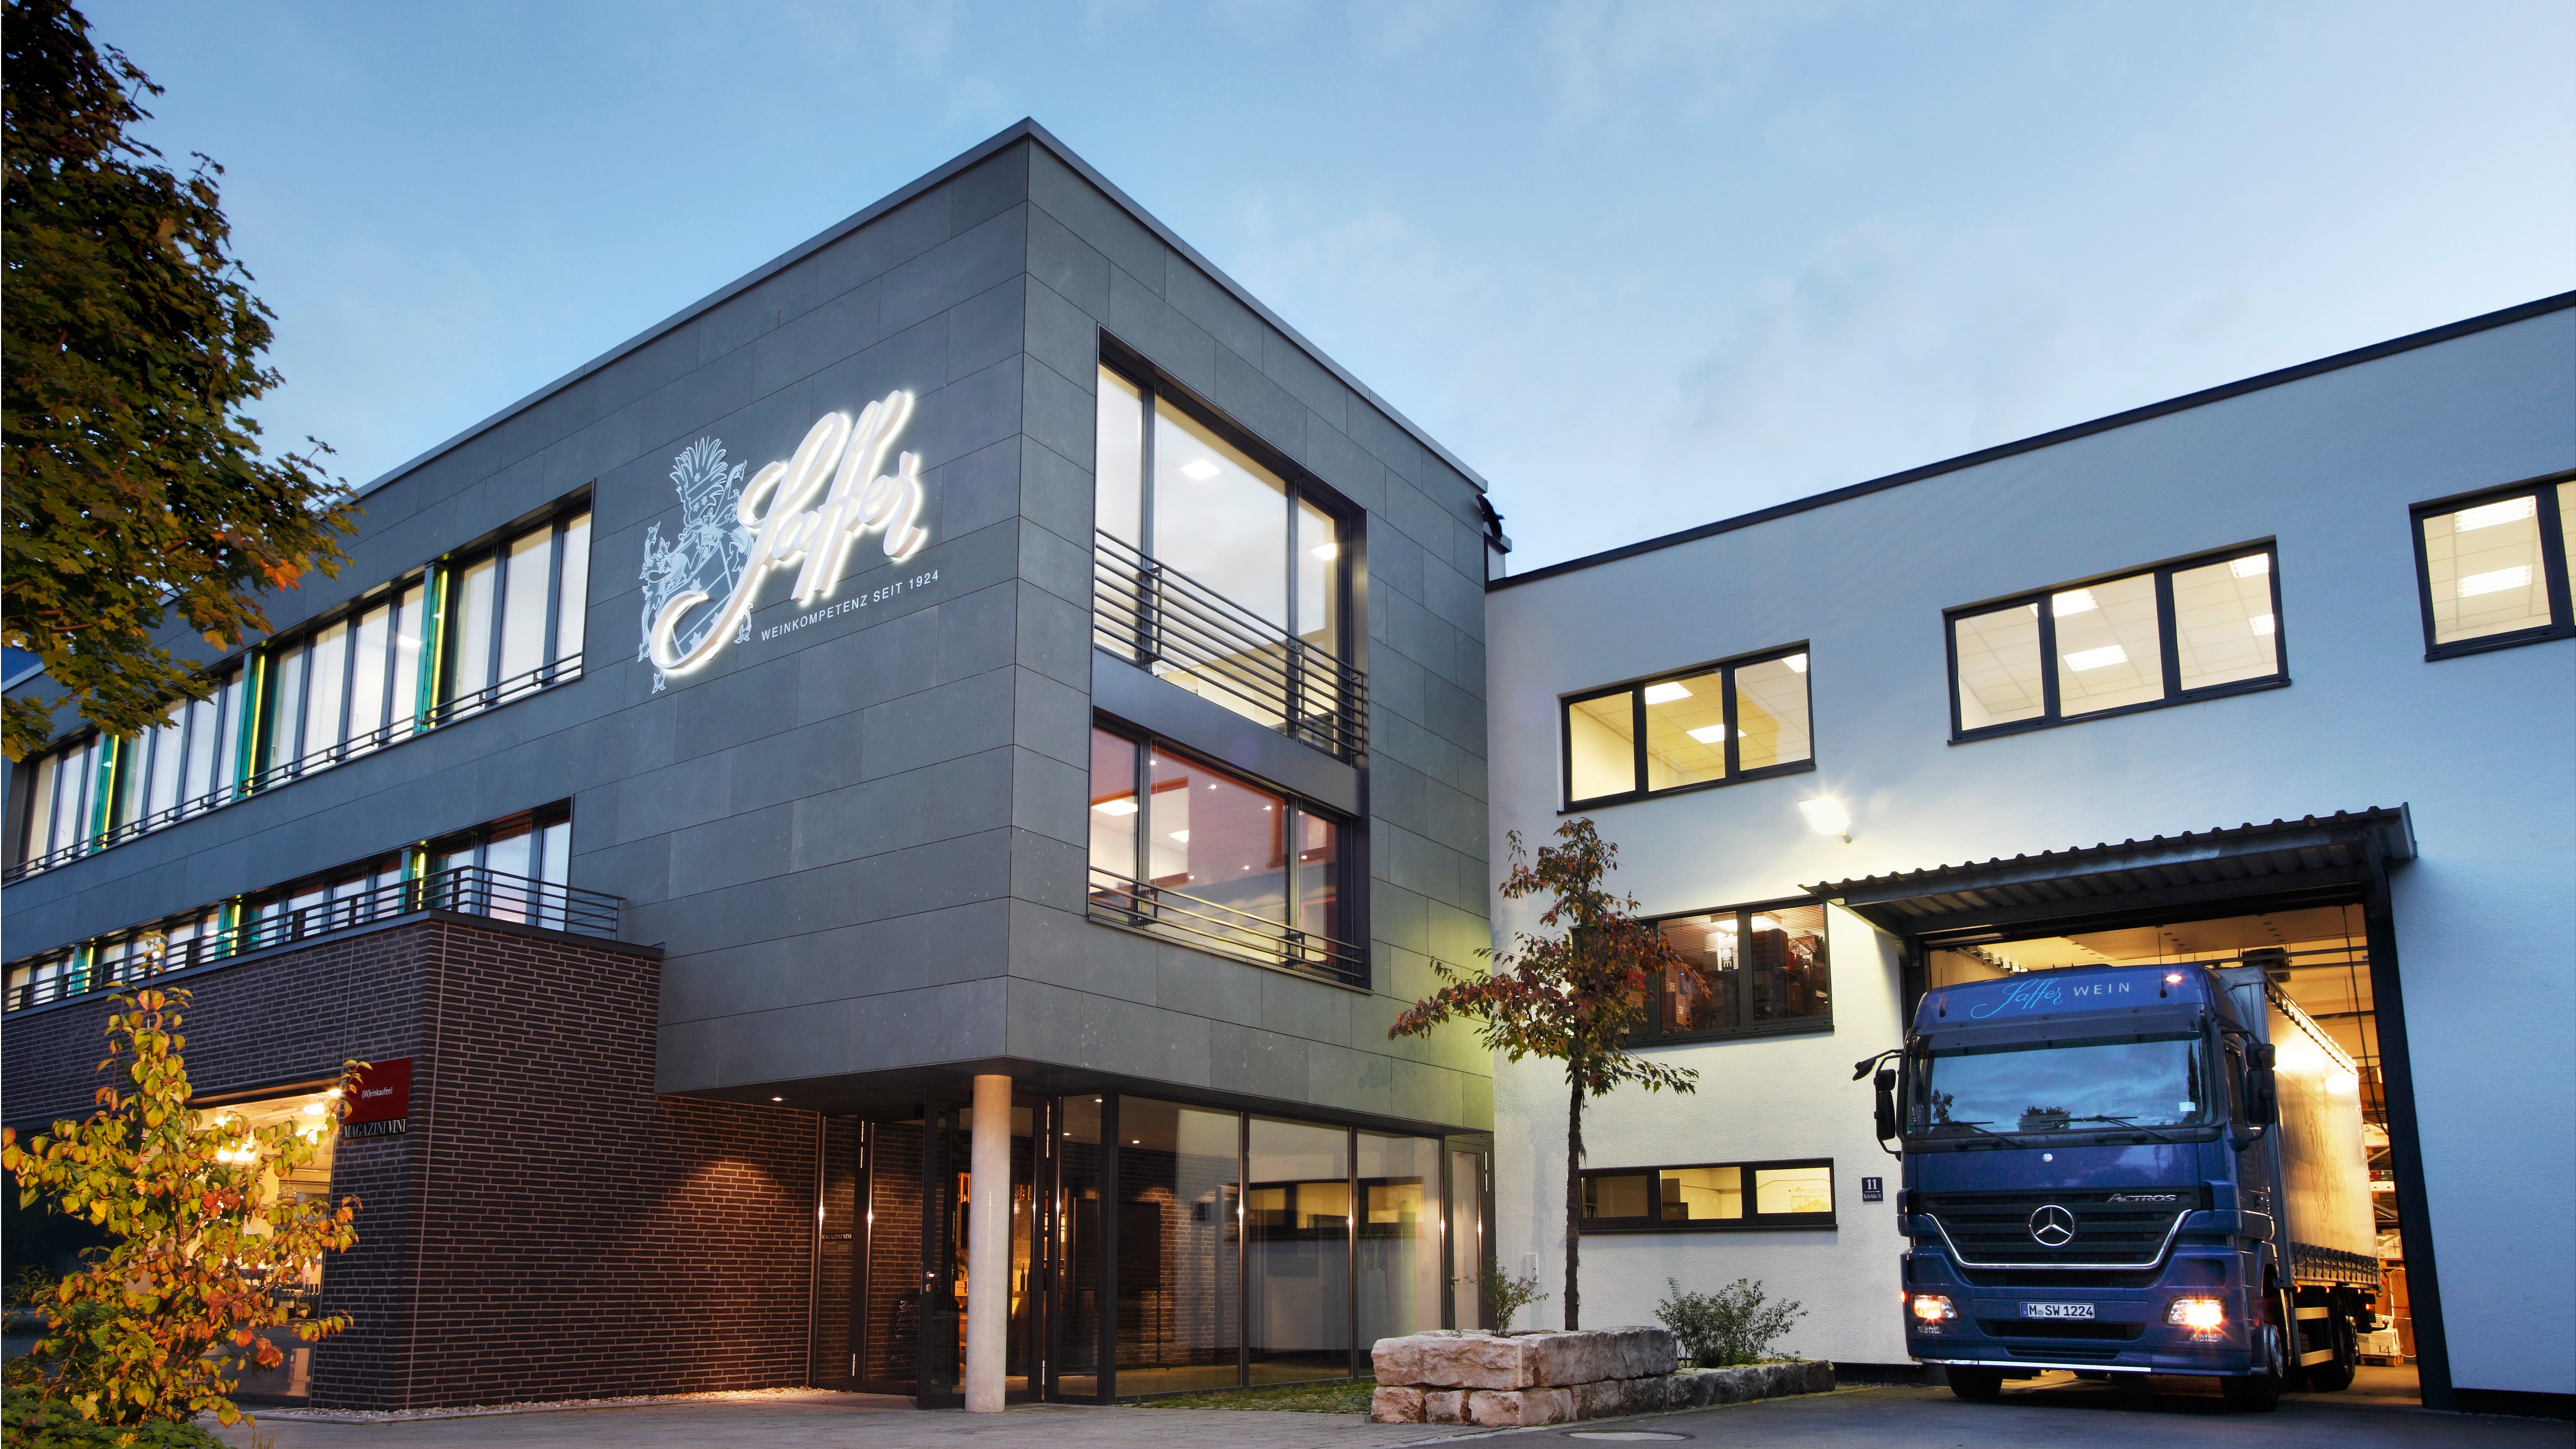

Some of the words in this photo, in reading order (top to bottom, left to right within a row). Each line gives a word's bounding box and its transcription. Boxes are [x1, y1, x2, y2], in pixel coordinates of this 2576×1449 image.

[649, 390, 922, 670] Saffer
[761, 595, 868, 641] WEINKOMPETENZ
[873, 582, 903, 603] SEIT
[909, 569, 939, 590] 1924
[1970, 977, 2063, 1018] Saffer
[2073, 982, 2130, 996] WEIN
[362, 1086, 393, 1099] (W)einkaufen!
[343, 1121, 387, 1138] MAGAZINI
[387, 1118, 407, 1133] VINI
[1866, 1179, 1878, 1190] 11
[2063, 1306, 2093, 1317] 1224
